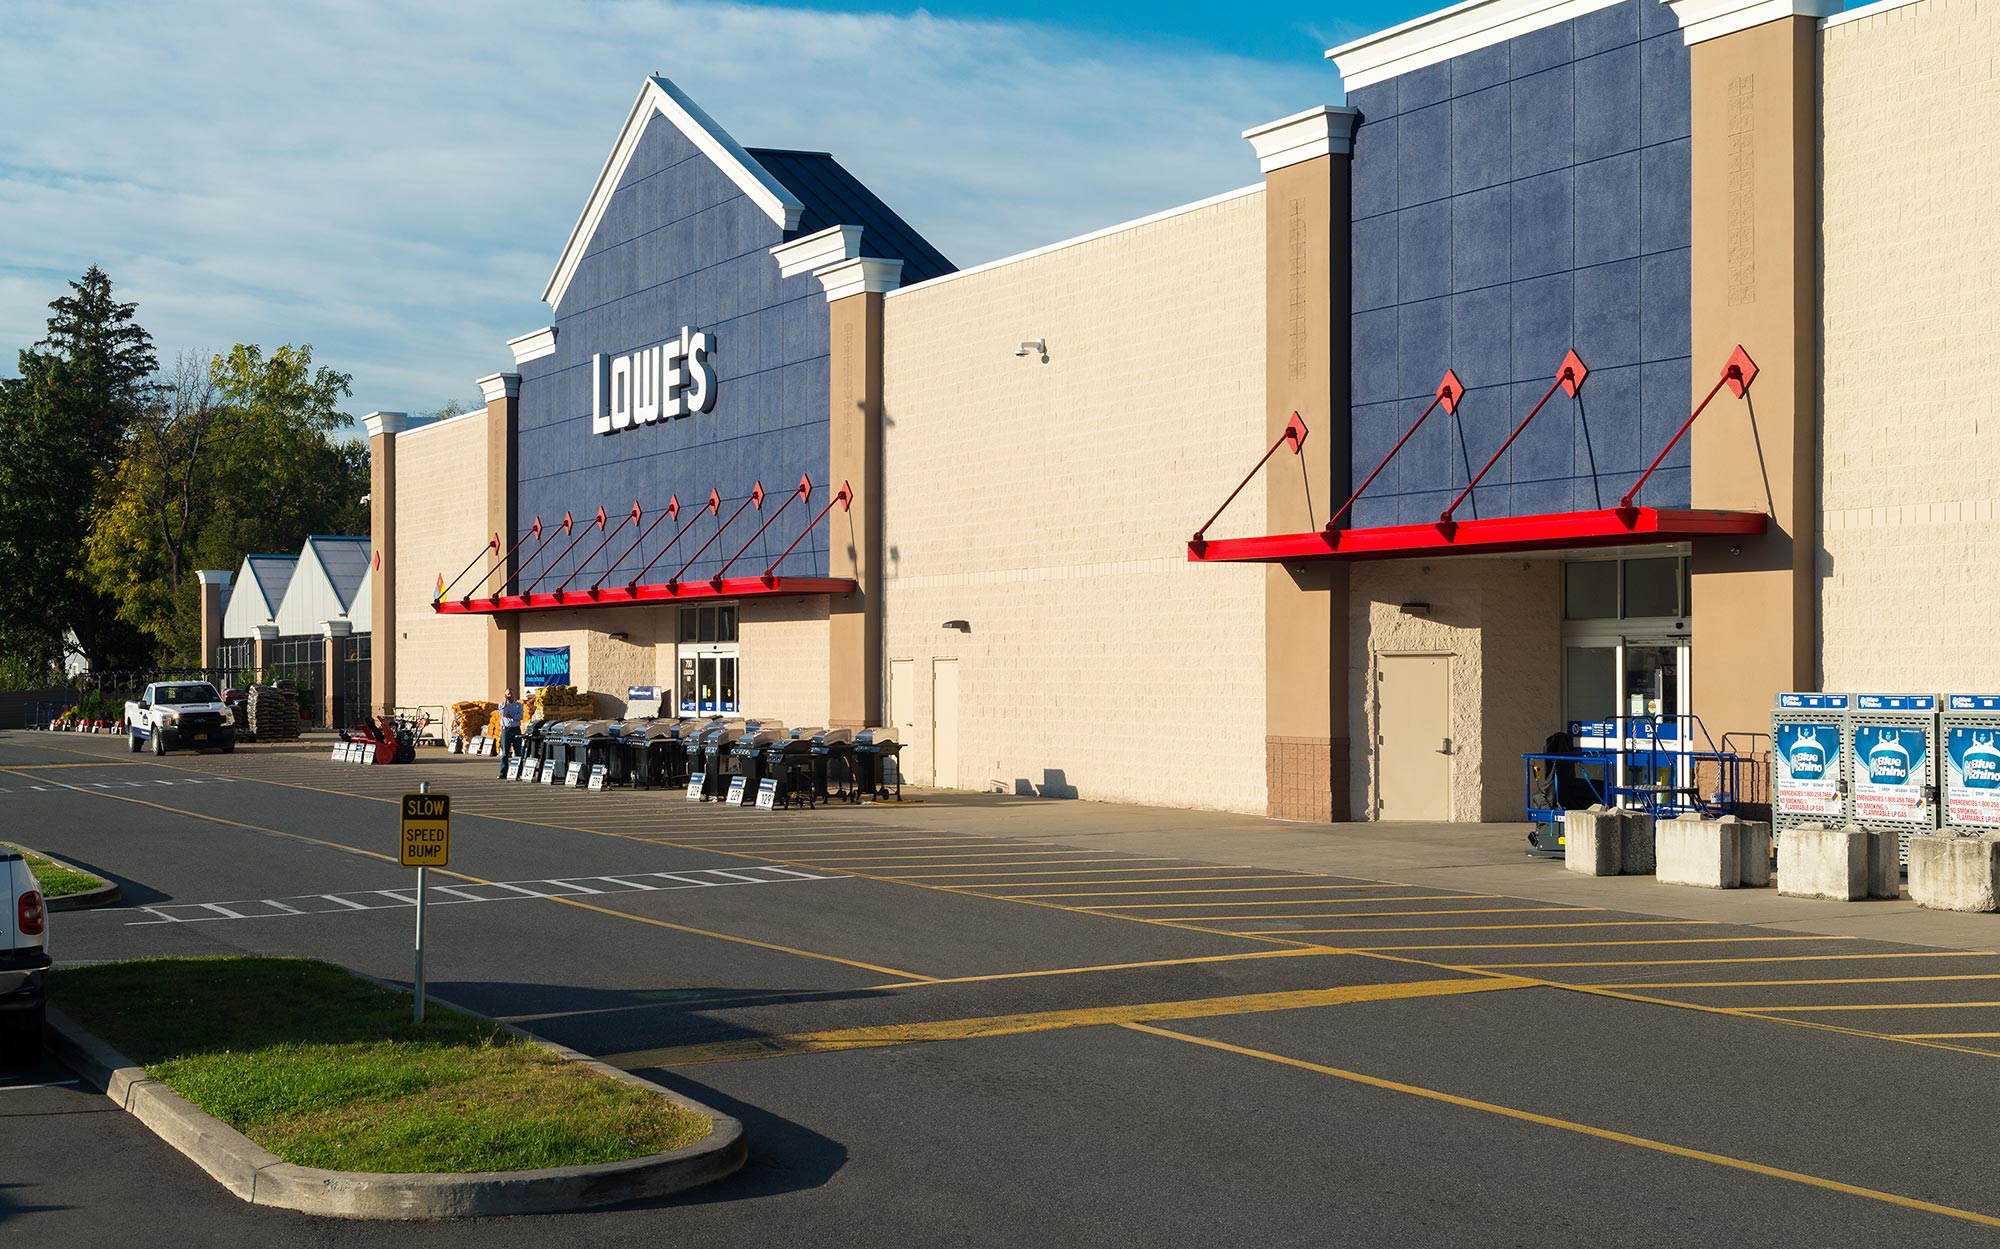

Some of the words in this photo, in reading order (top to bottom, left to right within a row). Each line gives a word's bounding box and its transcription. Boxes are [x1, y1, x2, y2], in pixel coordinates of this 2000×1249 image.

[593, 326, 707, 434] LOWE'S
[526, 656, 542, 675] NOW
[544, 654, 569, 675] HIRING
[1645, 724, 1658, 733] EXT
[1797, 752, 1818, 762] Blue
[1877, 756, 1901, 766] Blue
[1971, 759, 1996, 770] Blue
[408, 800, 445, 815] SLOW
[1956, 814, 1985, 822] FLAMMABLE
[407, 829, 444, 842] SPEED
[408, 845, 441, 858] BUMP
